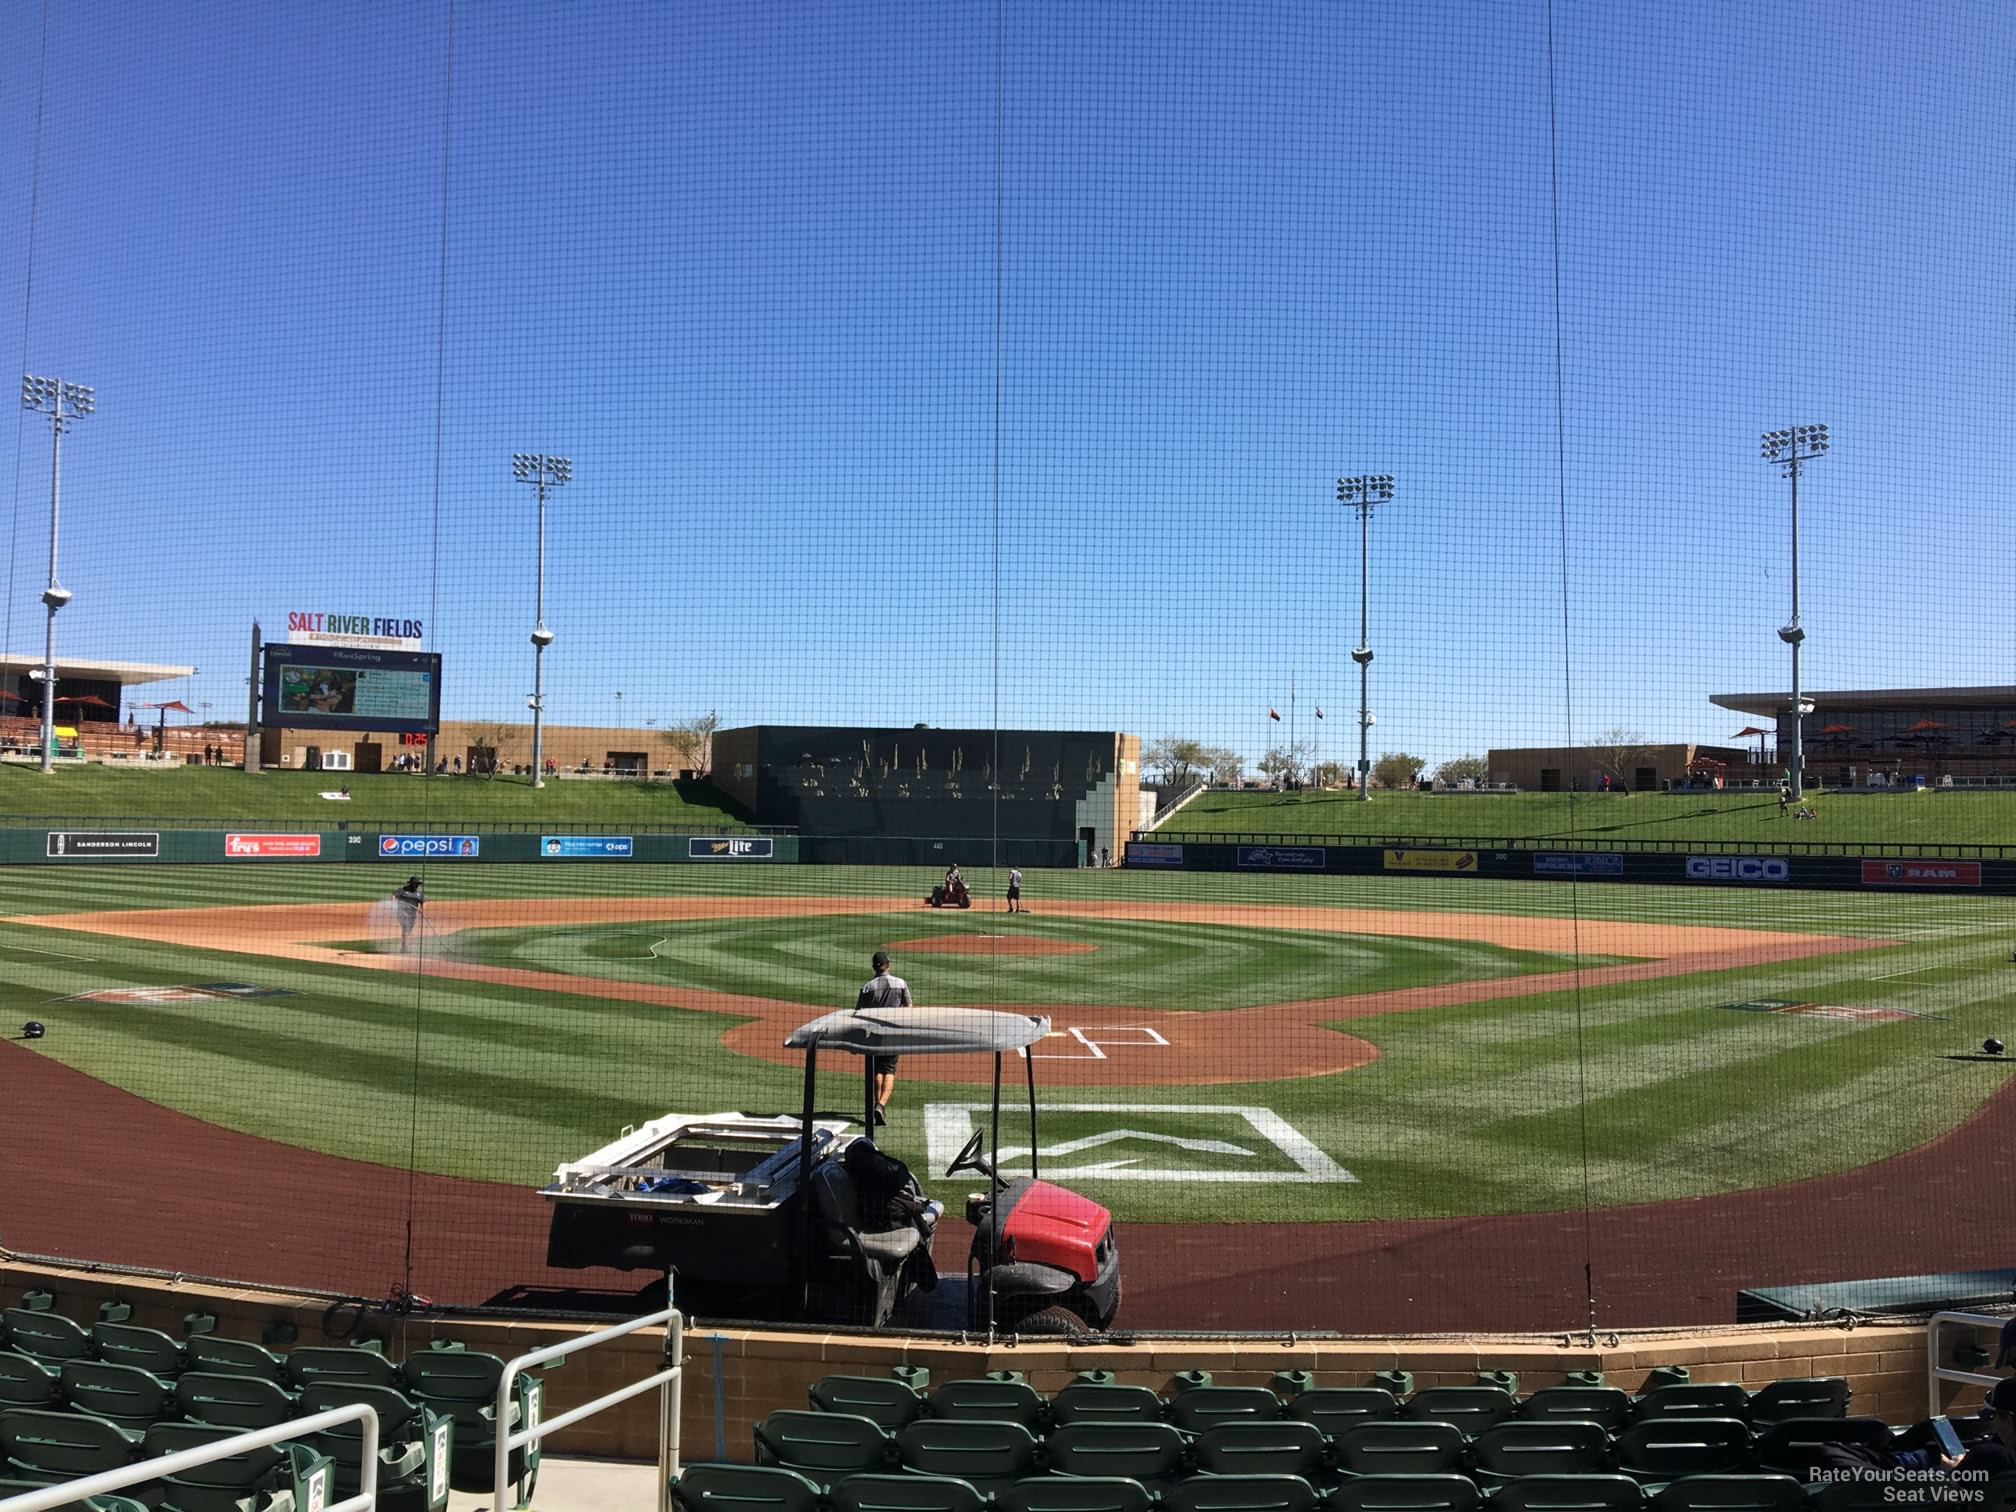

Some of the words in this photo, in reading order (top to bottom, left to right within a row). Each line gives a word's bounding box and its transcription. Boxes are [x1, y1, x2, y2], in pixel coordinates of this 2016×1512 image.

[288, 611, 324, 632] SALT
[327, 615, 370, 636] RIVER
[374, 618, 423, 639] FIELDS
[333, 652, 381, 662] #RoxSpring
[401, 838, 452, 854] pepsi
[728, 840, 752, 855] Lite
[1687, 858, 1788, 879] GEICO
[1907, 869, 1957, 878] RAM
[629, 1213, 653, 1222] TORO
[659, 1216, 705, 1226] WORKMAN
